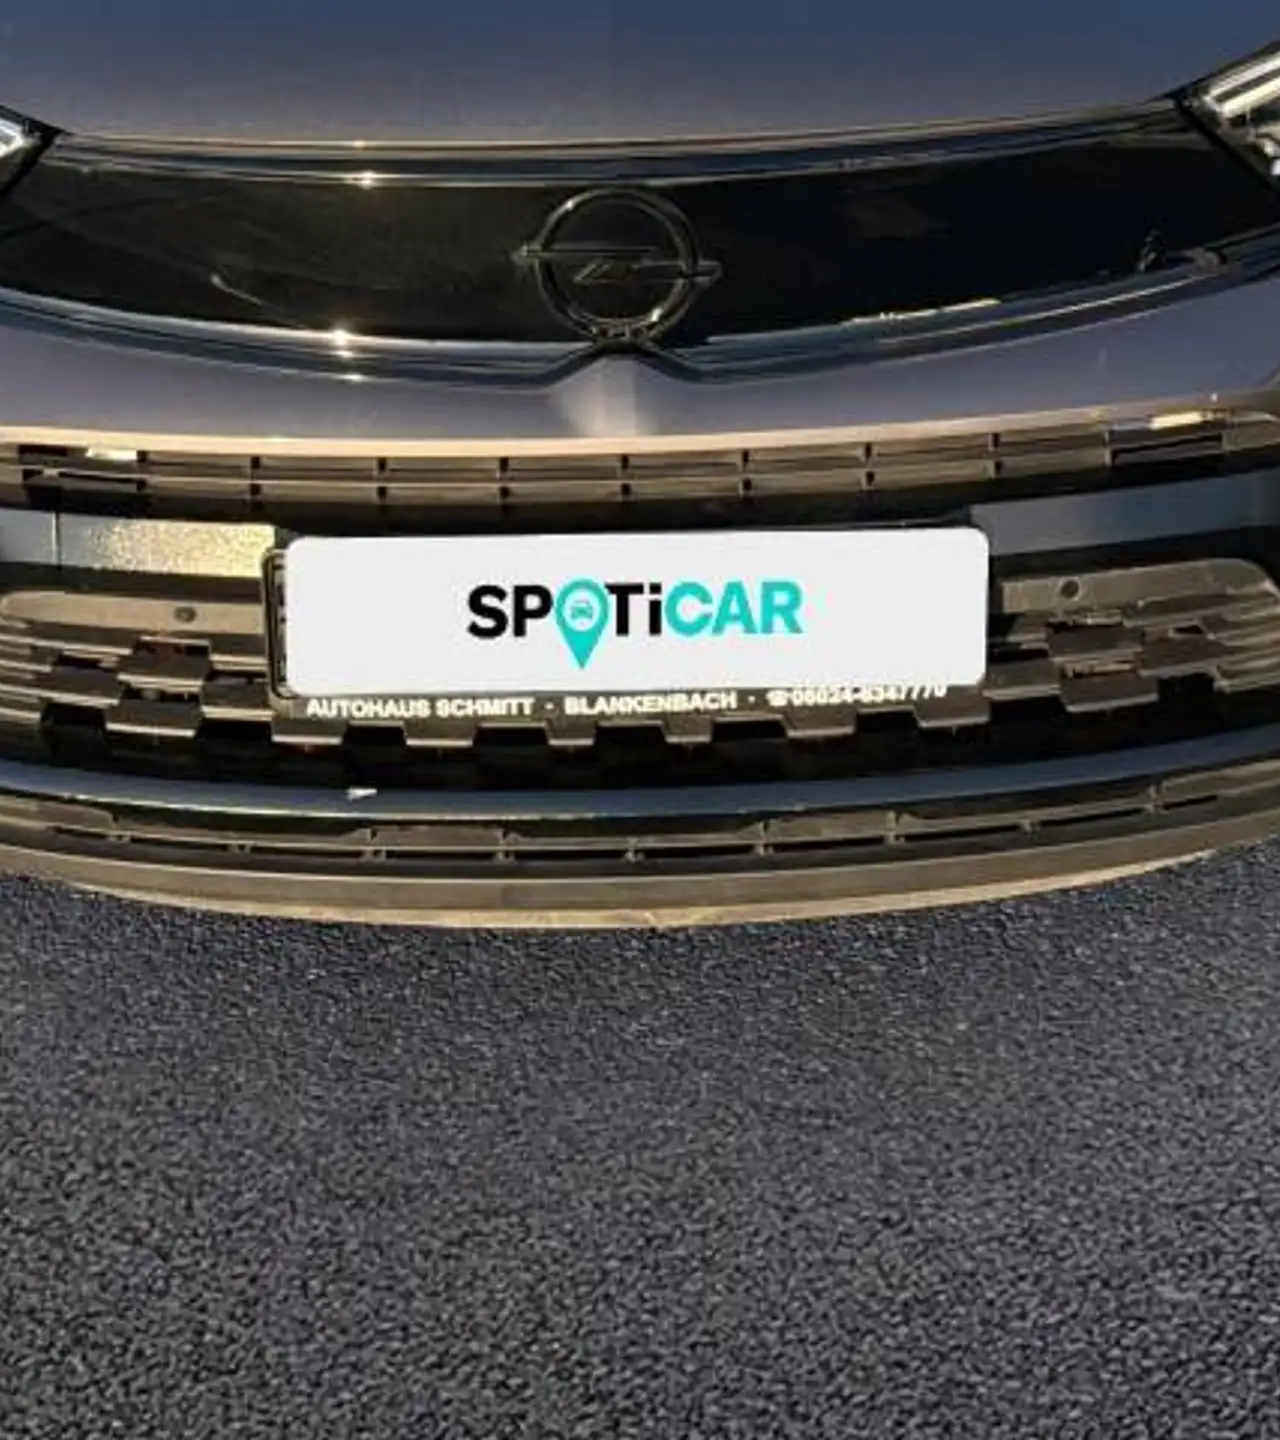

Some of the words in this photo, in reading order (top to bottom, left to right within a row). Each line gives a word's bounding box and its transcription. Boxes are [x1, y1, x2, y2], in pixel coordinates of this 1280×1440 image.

[306, 697, 430, 719] AUTOHAUS
[435, 697, 536, 718] SCHMITT
[564, 691, 738, 716] BLANKENBACH
